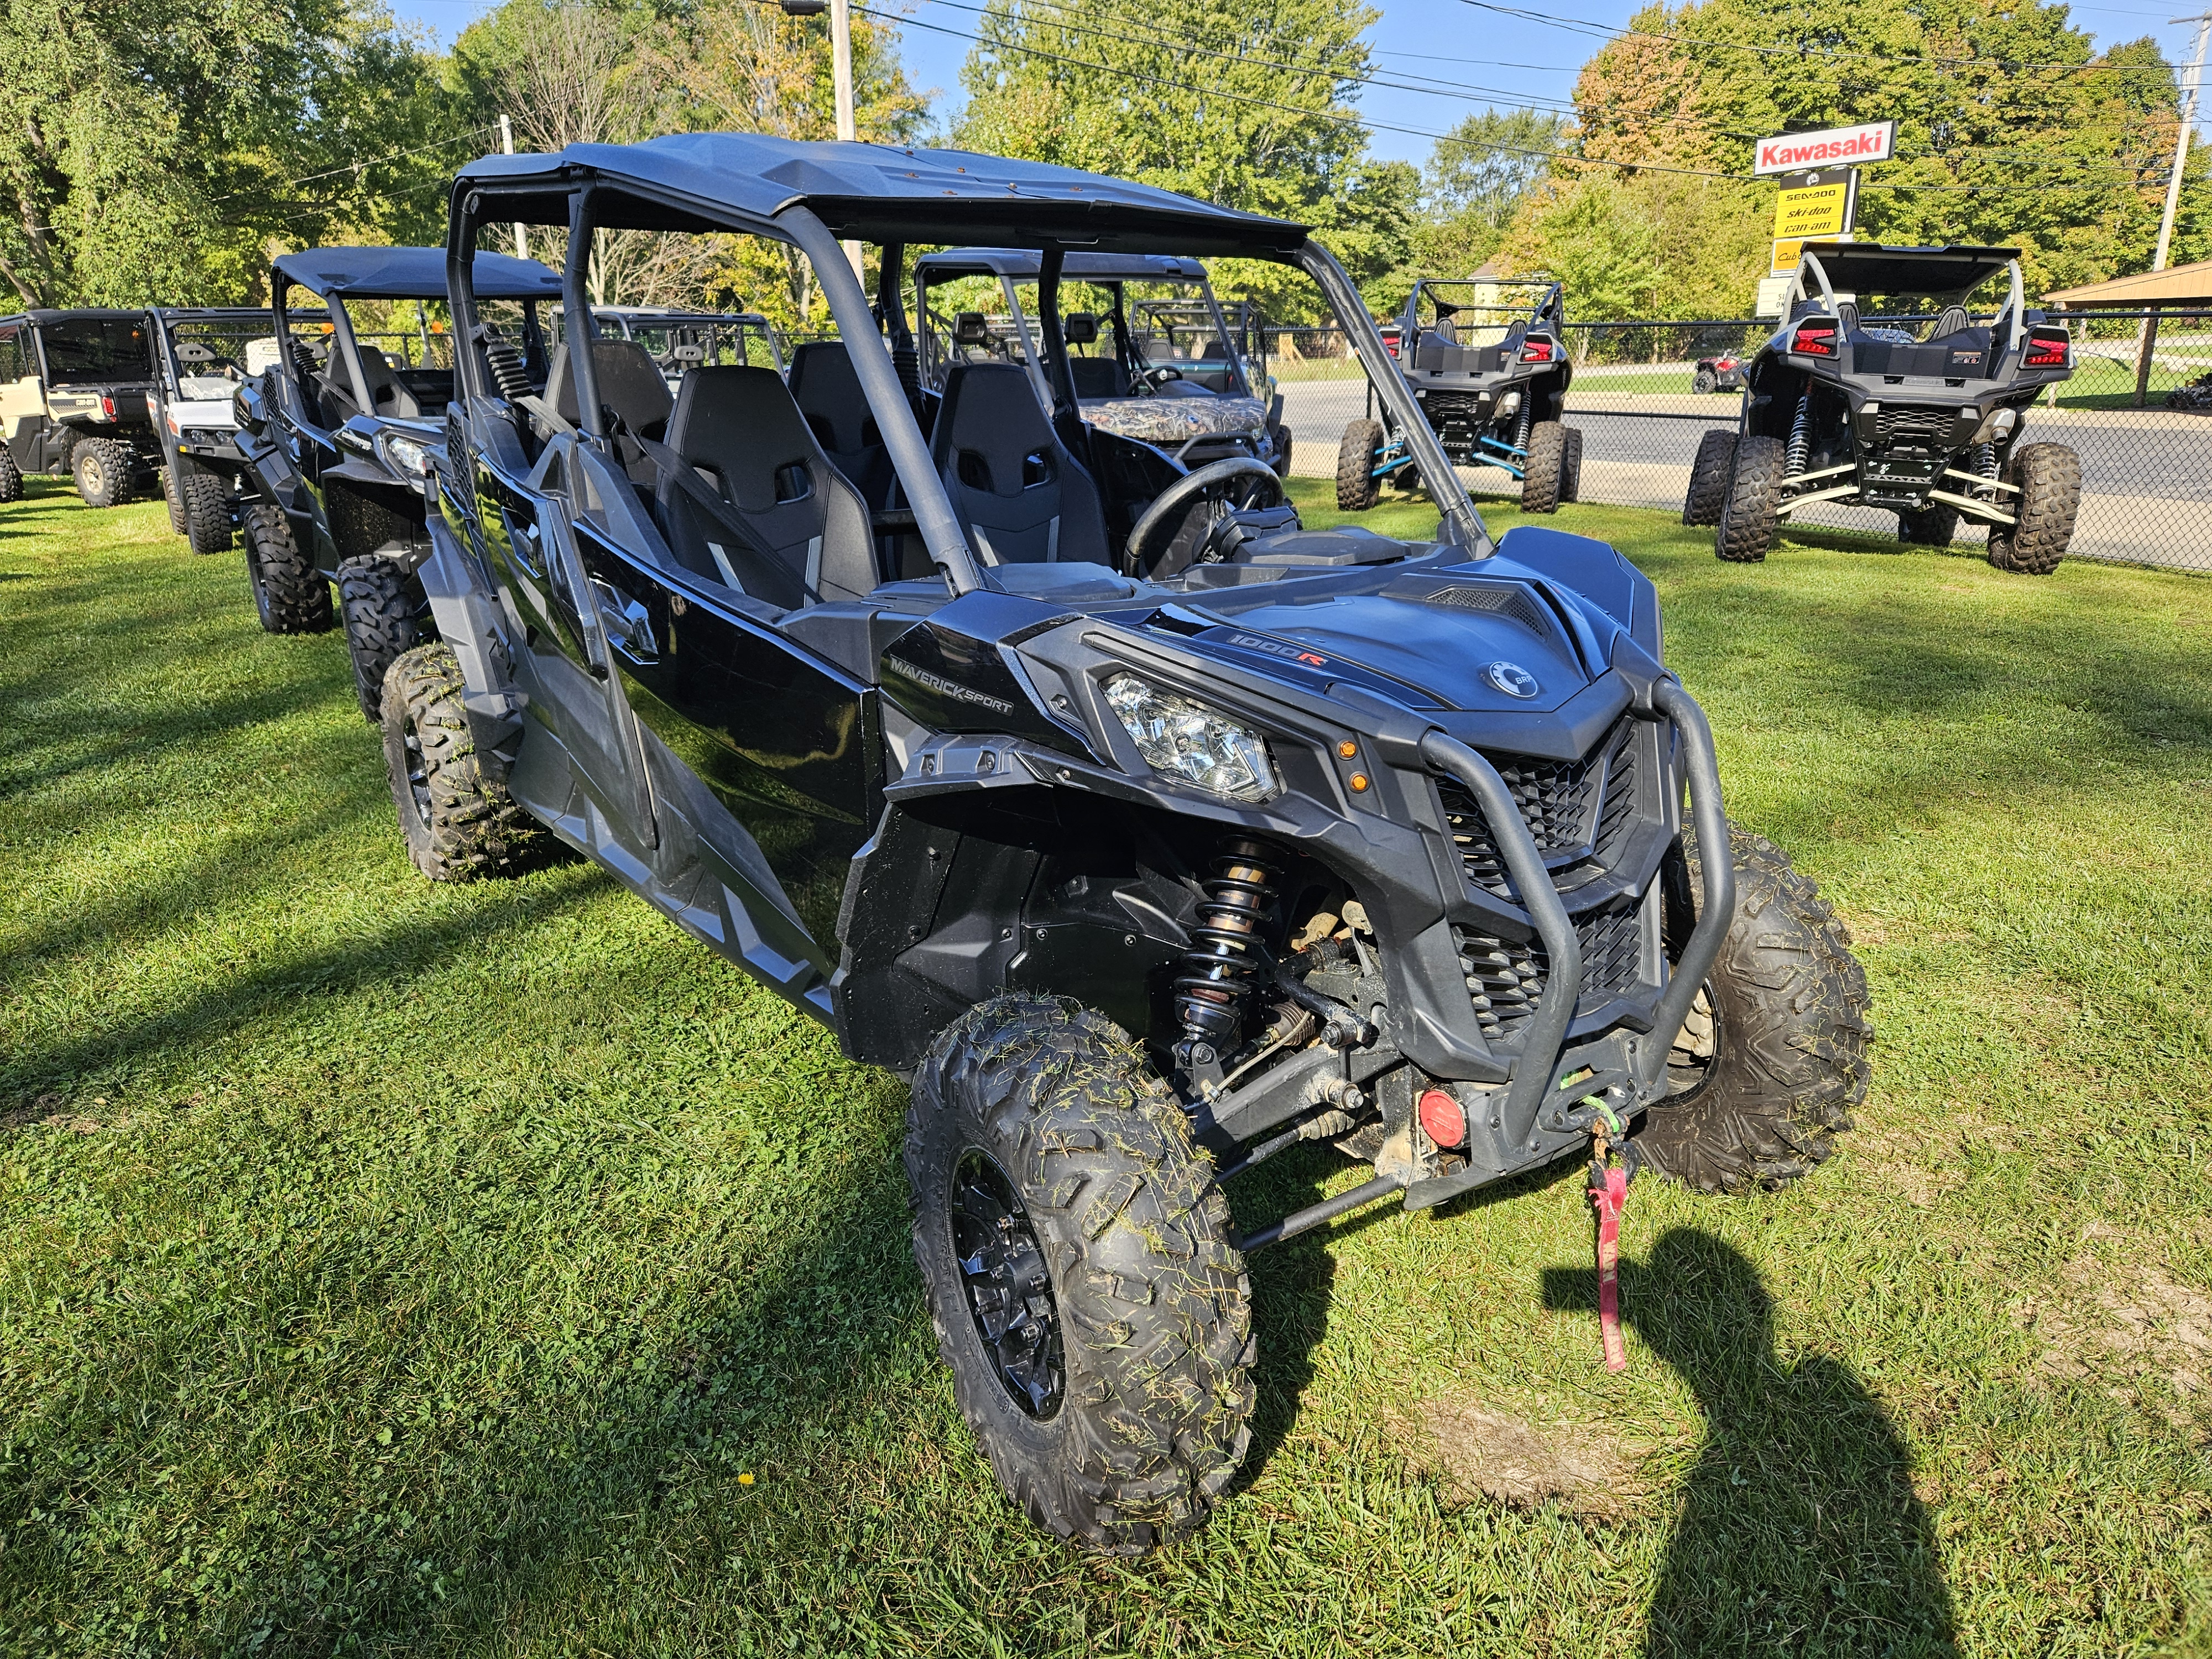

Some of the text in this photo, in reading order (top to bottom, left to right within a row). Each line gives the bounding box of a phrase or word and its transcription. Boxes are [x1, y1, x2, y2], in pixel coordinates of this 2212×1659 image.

[1761, 131, 1882, 167] Kawasaki
[1787, 207, 1832, 218] ski-doo
[1784, 221, 1831, 233] can-am
[1778, 252, 1797, 261] Cub
[891, 656, 1013, 713] MAVERICK SPORT
[1515, 676, 1532, 684] BRP
